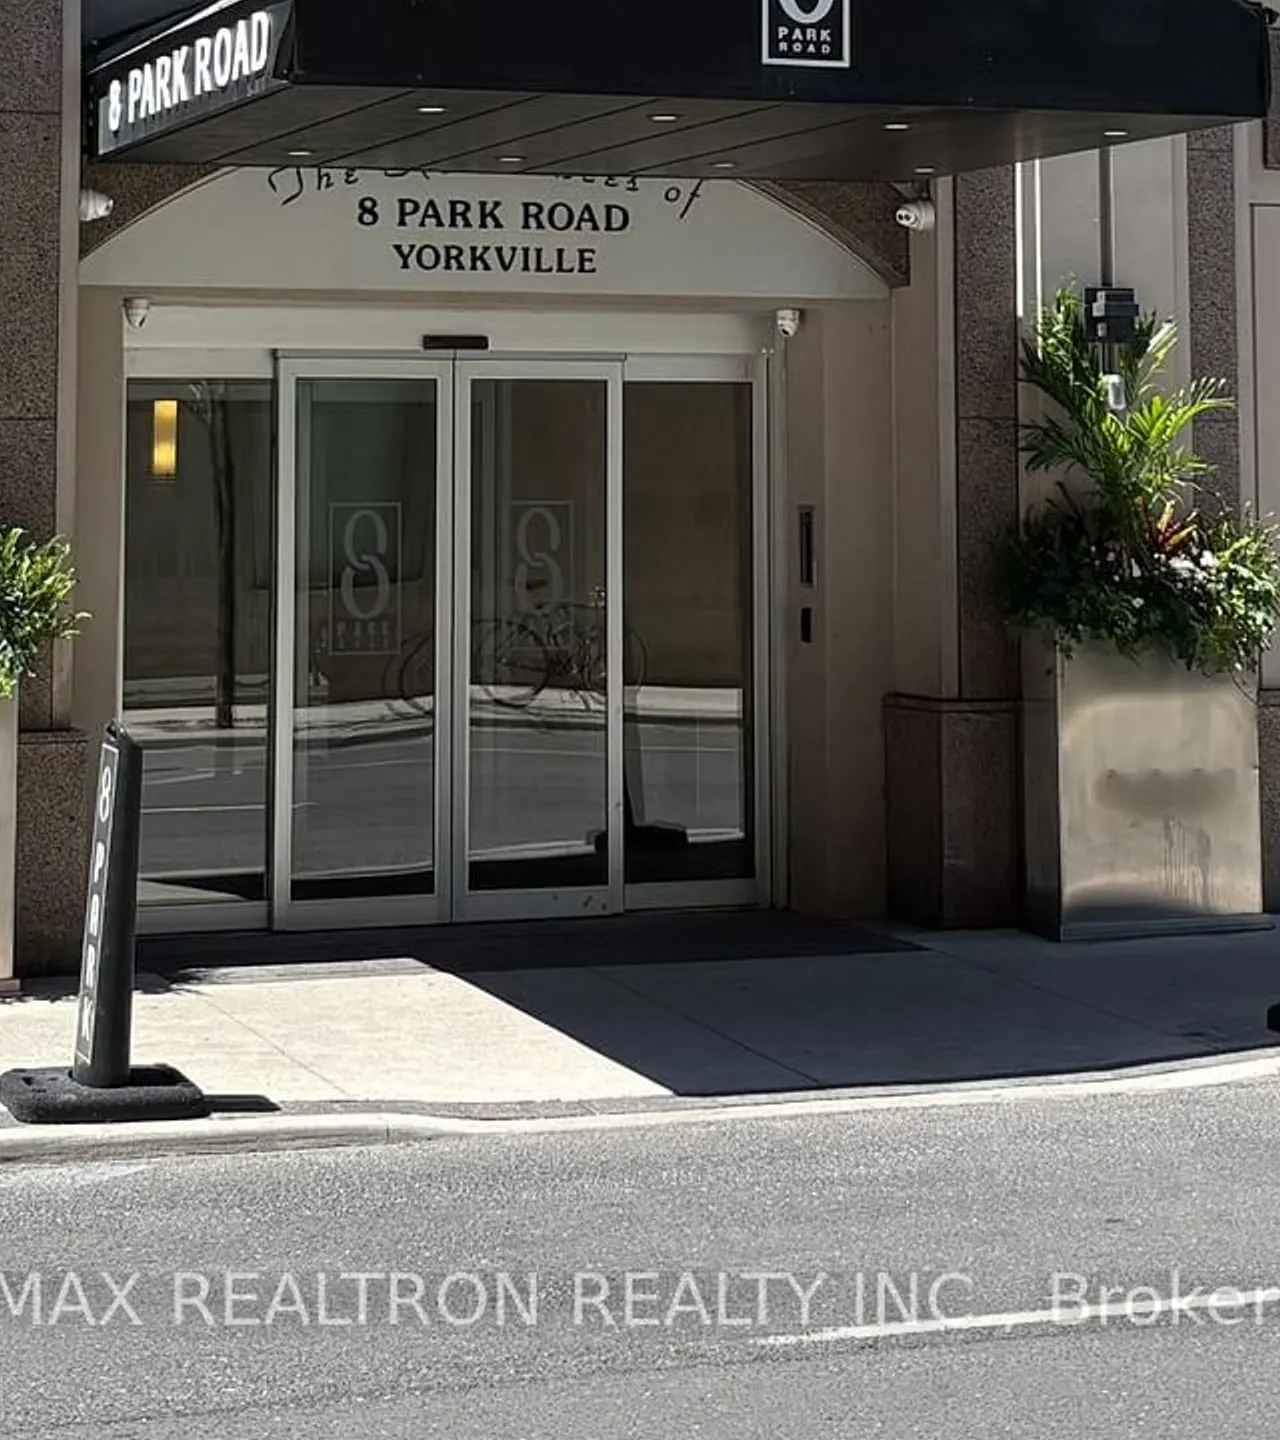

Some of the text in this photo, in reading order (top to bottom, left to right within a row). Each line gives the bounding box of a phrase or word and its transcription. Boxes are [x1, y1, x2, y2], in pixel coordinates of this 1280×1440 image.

[778, 26, 833, 42] PARK
[778, 41, 832, 54] ROAD
[108, 11, 270, 131] 8 PARK ROAD
[357, 196, 631, 232] 8 PARK ROAD
[391, 243, 598, 274] YORKVILLE
[80, 765, 114, 1042] 8 PARK
